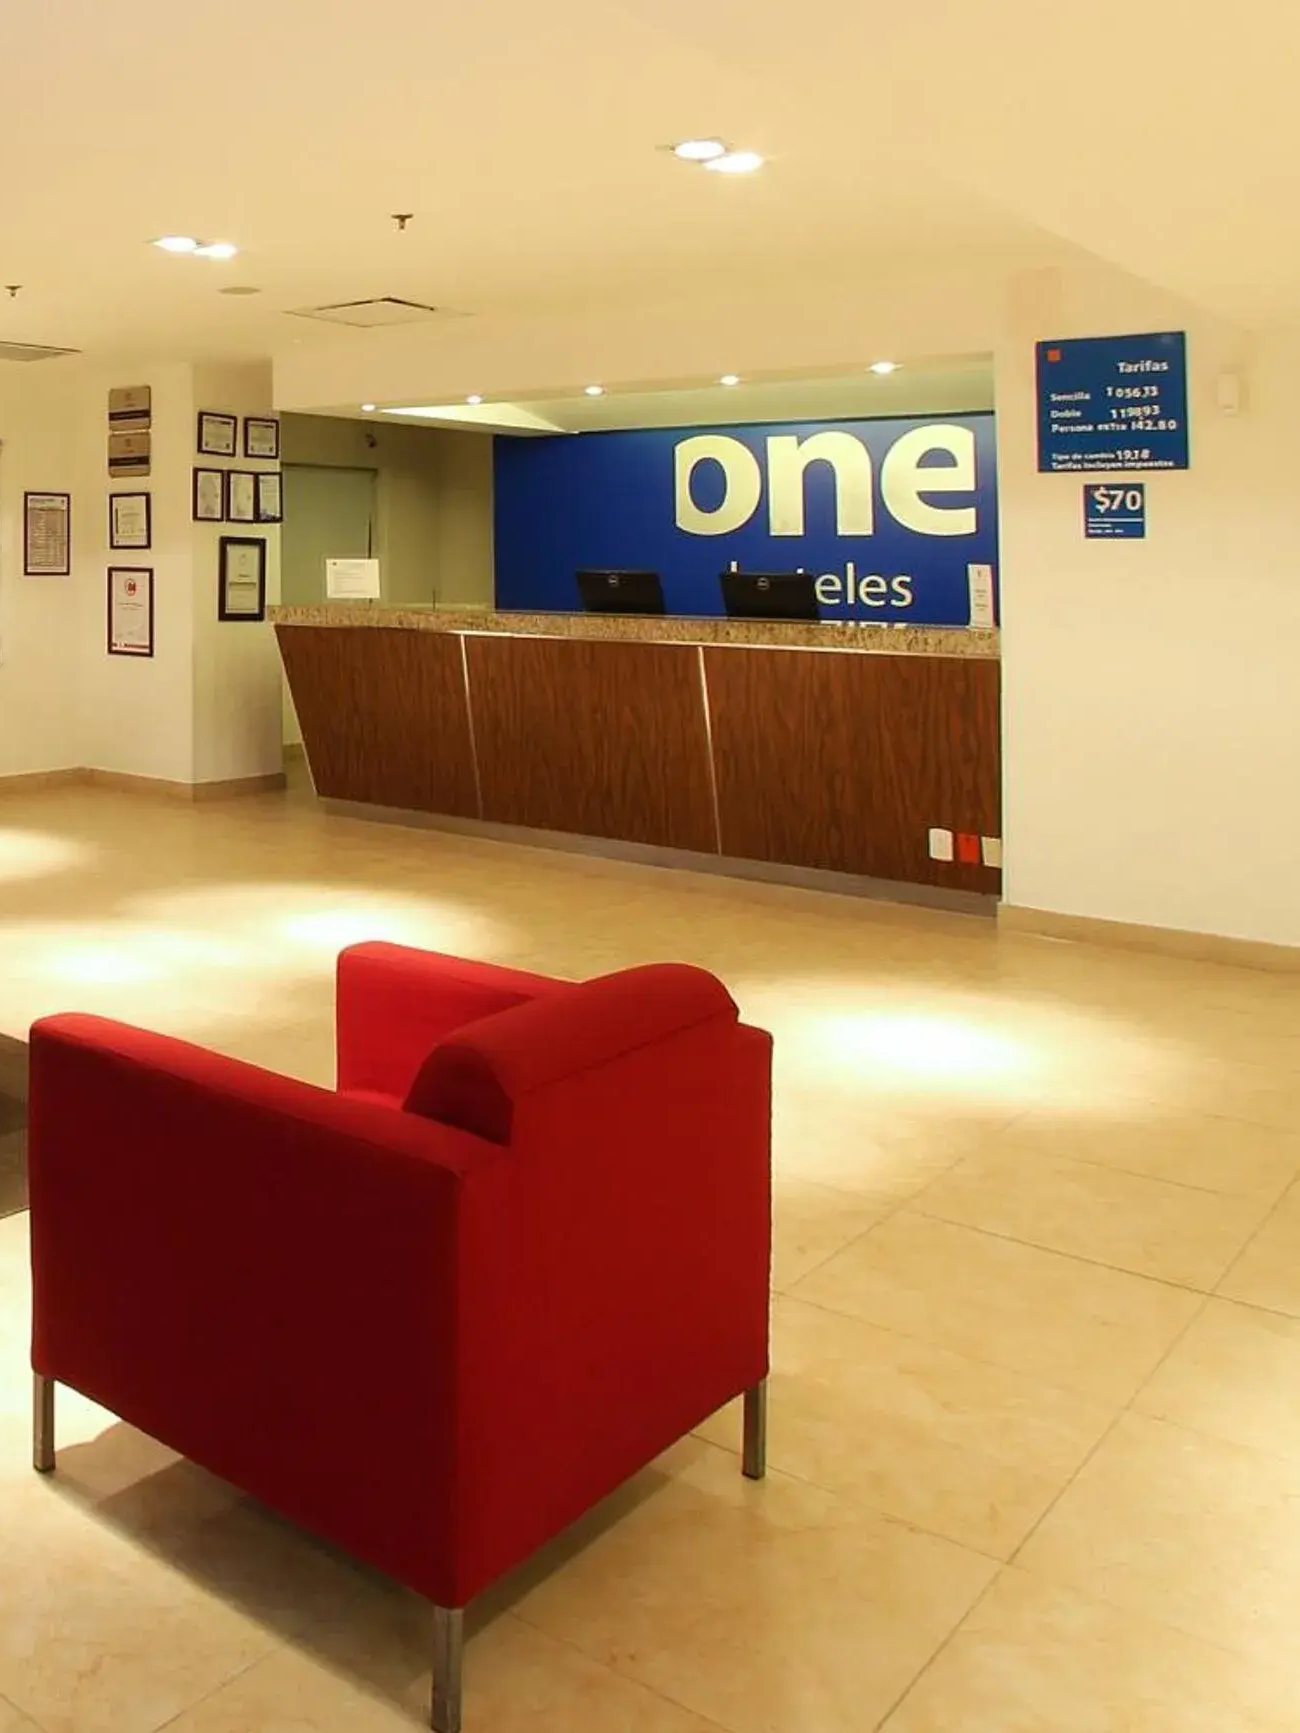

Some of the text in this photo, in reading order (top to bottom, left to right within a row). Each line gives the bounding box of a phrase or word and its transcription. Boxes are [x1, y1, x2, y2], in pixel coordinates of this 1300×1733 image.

[1117, 360, 1169, 374] Tarifas
[673, 423, 978, 537] one
[1093, 486, 1142, 513] $70
[730, 560, 914, 608] eles
